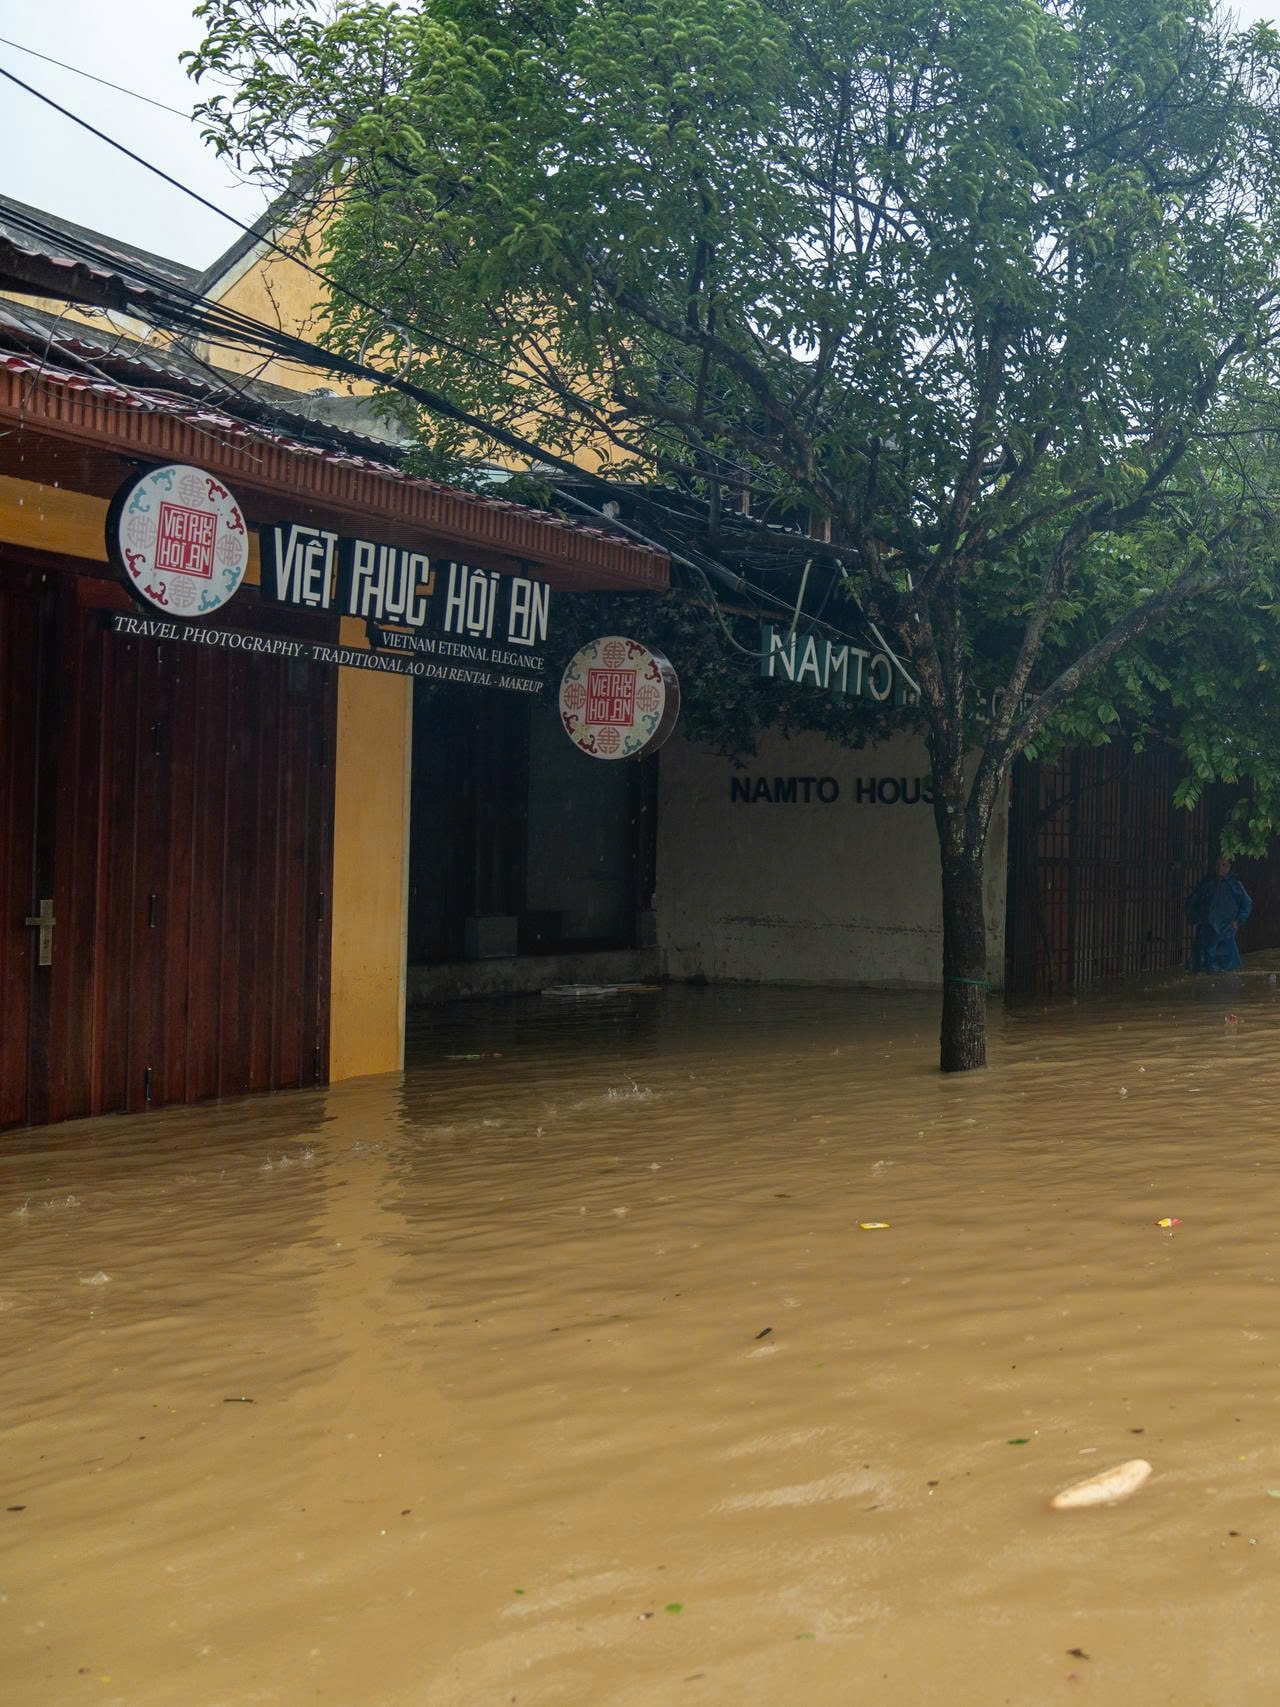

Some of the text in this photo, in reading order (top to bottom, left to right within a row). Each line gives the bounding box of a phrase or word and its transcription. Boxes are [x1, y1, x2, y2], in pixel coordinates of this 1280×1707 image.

[274, 524, 551, 647] VIỆT PHỤC HỘI AN
[114, 616, 181, 640] TRAVEL
[183, 627, 304, 657] PHOTOGRAPHY
[312, 646, 404, 673] TRADITIONAL
[405, 661, 425, 676] AO
[425, 664, 448, 679] DAI
[448, 668, 492, 686] RENTAL
[498, 676, 544, 693] MAKEUP
[382, 631, 545, 670] VIETNAM ETERNAL ELEGANCE
[768, 631, 893, 701] NAMTO
[731, 776, 840, 804] NAMTO
